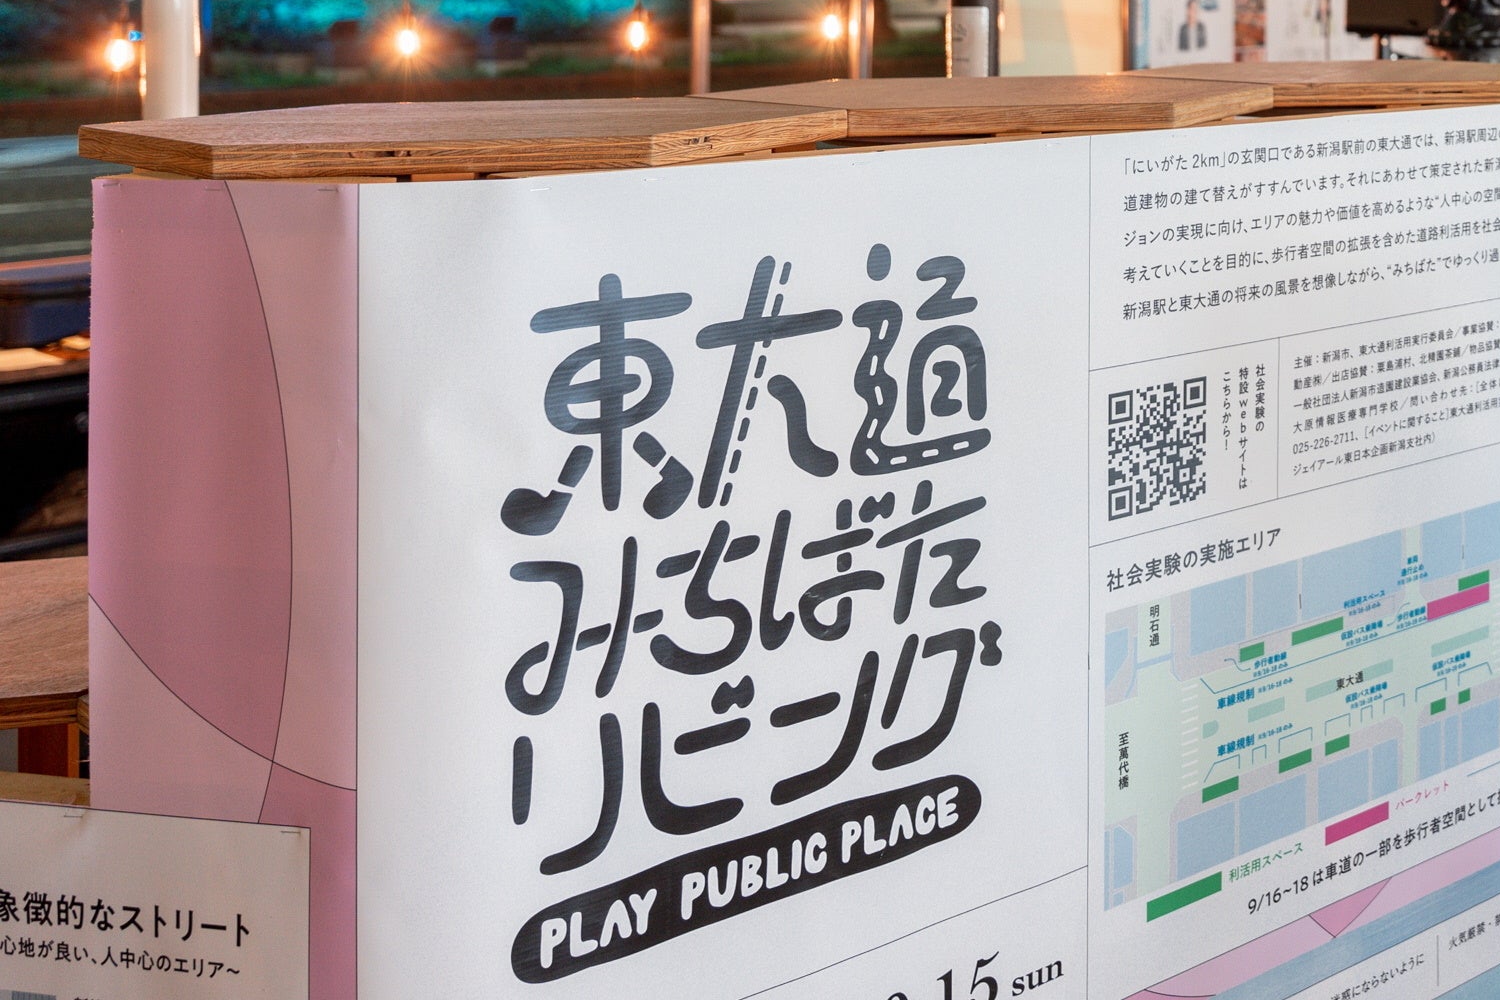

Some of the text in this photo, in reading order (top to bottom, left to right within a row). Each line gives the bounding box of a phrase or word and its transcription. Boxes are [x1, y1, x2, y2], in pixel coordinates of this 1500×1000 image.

[500, 243, 992, 537] 東大通
[1255, 363, 1266, 432] 社会実験の
[1238, 366, 1249, 490] 特設webサイトは
[1106, 527, 1282, 593] 社会実験の実施エリア
[505, 480, 988, 717] みちばた
[1149, 603, 1160, 648] 明石通
[1217, 687, 1255, 710] 車線規制
[1336, 670, 1364, 691] 東大通
[512, 620, 1003, 876] リビング
[1118, 731, 1129, 790] 至萬代橋
[1217, 733, 1255, 757] 車線規制
[1395, 781, 1450, 810] パークレット
[540, 784, 961, 969] PLAY PUBLIC PLACE
[1228, 842, 1304, 883] 利活用スペース
[1012, 959, 1065, 997] sun
